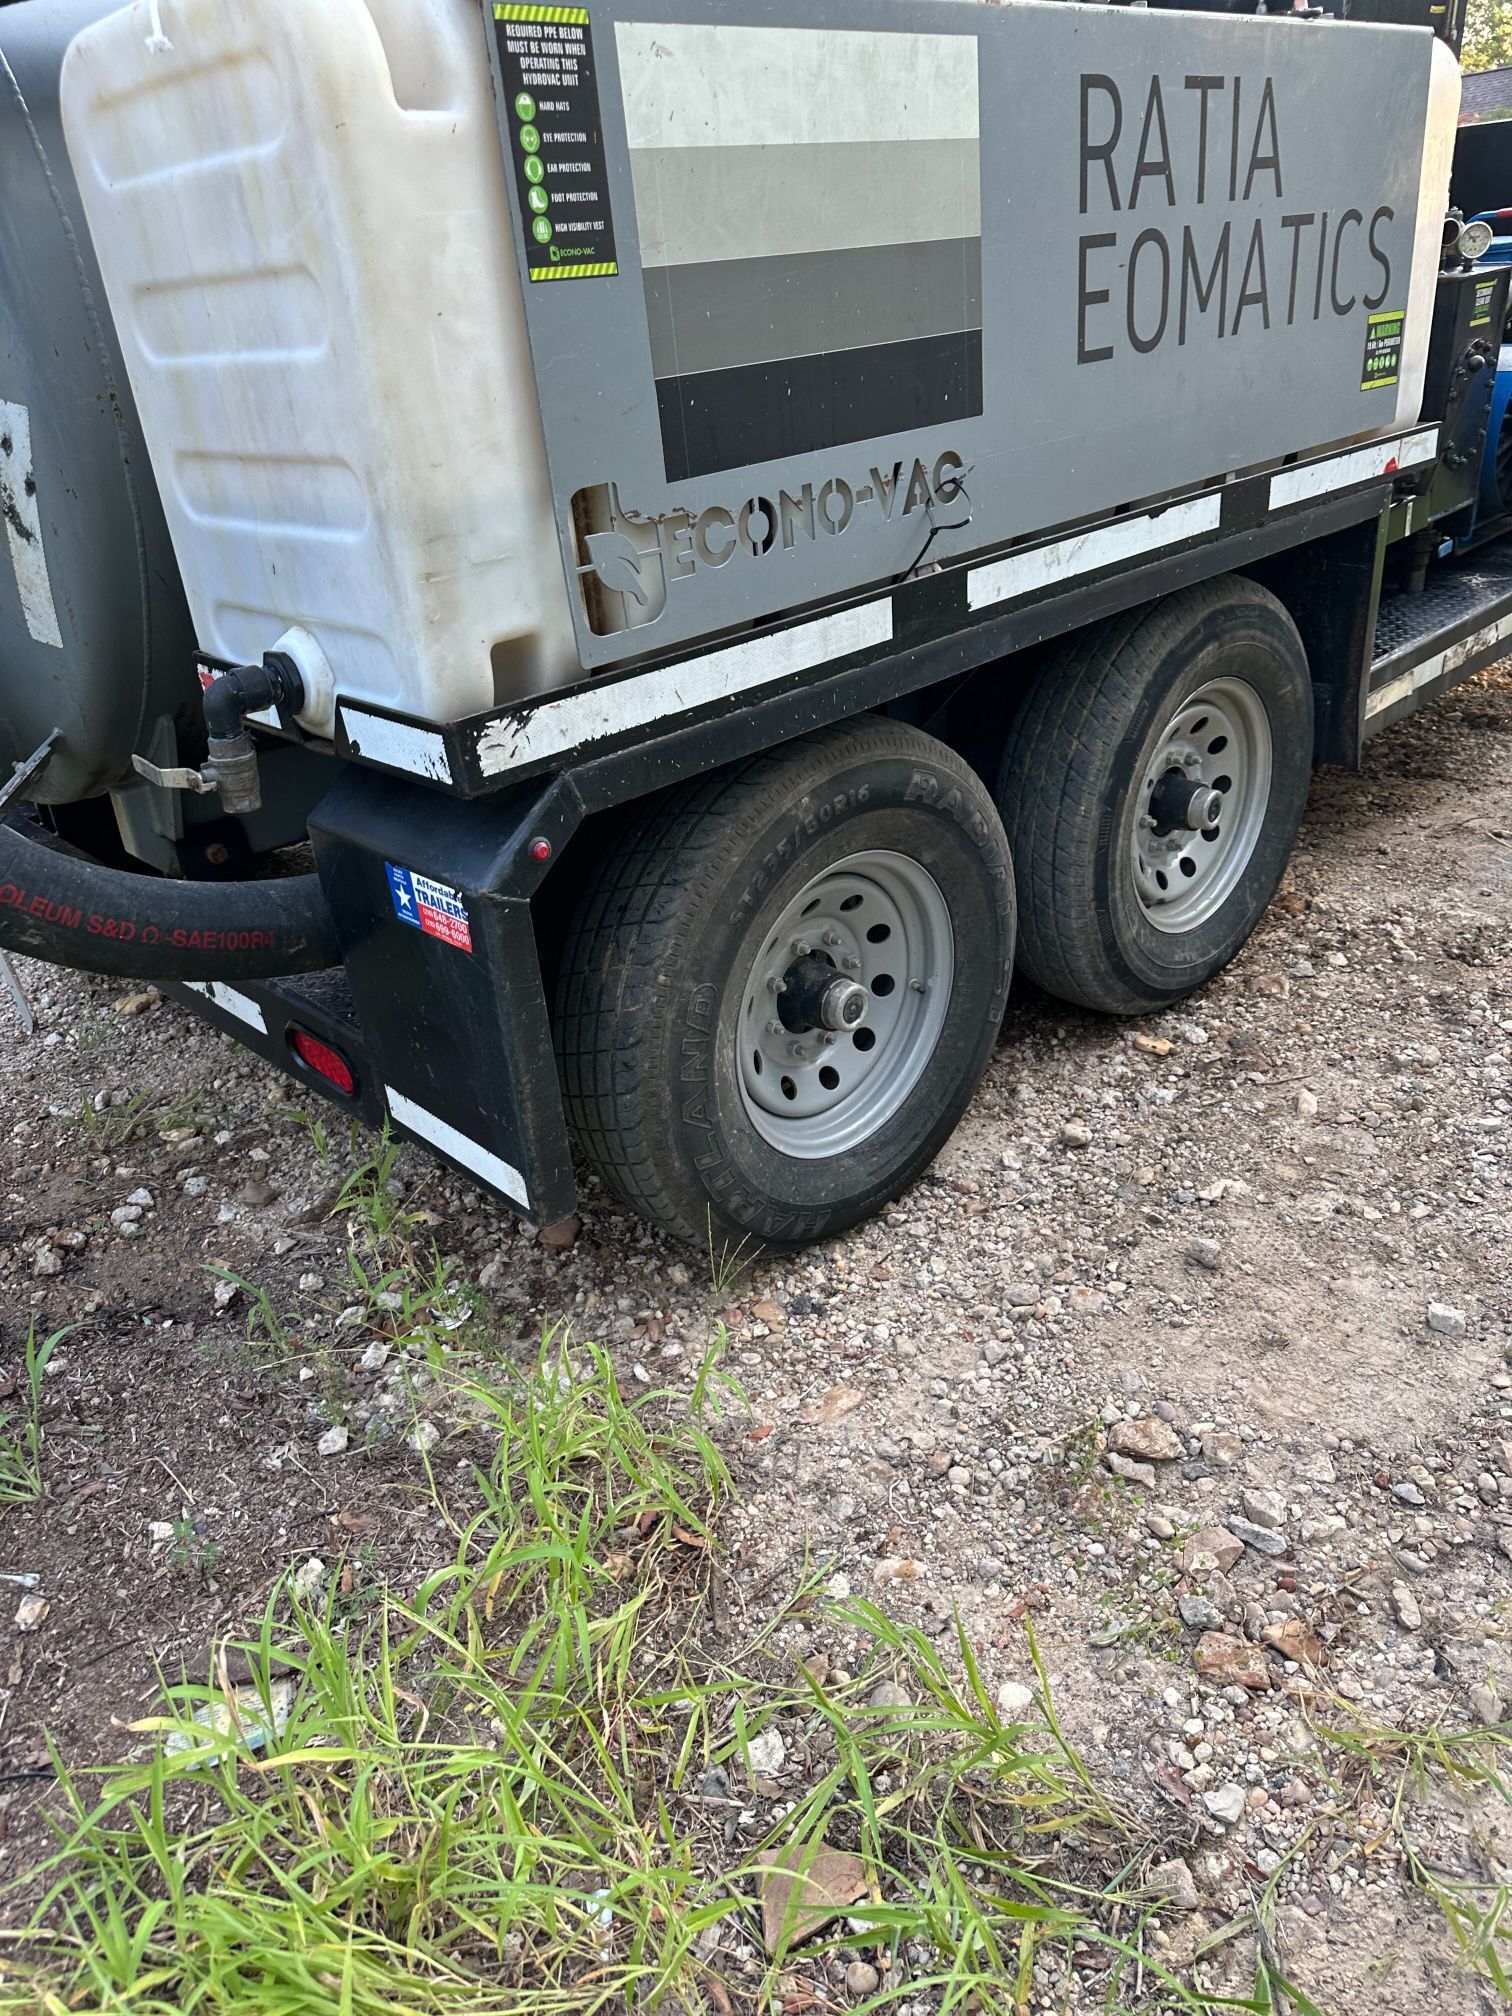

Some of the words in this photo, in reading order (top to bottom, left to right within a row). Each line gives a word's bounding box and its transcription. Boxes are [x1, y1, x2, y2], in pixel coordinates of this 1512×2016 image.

[506, 24, 542, 38] REQUIRED
[543, 26, 557, 39] PPE
[558, 27, 583, 40] BELOW
[506, 40, 528, 53] MUST
[529, 41, 540, 54] BE
[540, 42, 564, 55] WORN
[564, 43, 586, 56] WHEN
[520, 57, 560, 70] OPERATING
[561, 58, 578, 71] THIS
[522, 72, 561, 86] HYDROVAC
[561, 74, 579, 87] UNIT
[539, 101, 555, 111] HARD
[555, 101, 570, 112] HATS
[543, 132, 553, 143] EYE
[553, 132, 587, 143] PROTECTION
[1079, 73, 1283, 214] RATIA
[547, 163, 558, 173] EAR
[558, 162, 592, 173] PROTECTION
[551, 193, 565, 203] FOOT
[565, 191, 599, 203] PROTECTION
[554, 222, 568, 233] HIGH
[568, 221, 592, 232] VISIBILITY
[592, 220, 605, 231] VEST
[560, 246, 596, 257] ECONO-VAC
[1077, 205, 1395, 366] EOMATICS
[663, 449, 966, 583] ECONO-VAC
[414, 887, 469, 922] TRAILERS
[86, 914, 137, 941] S&D
